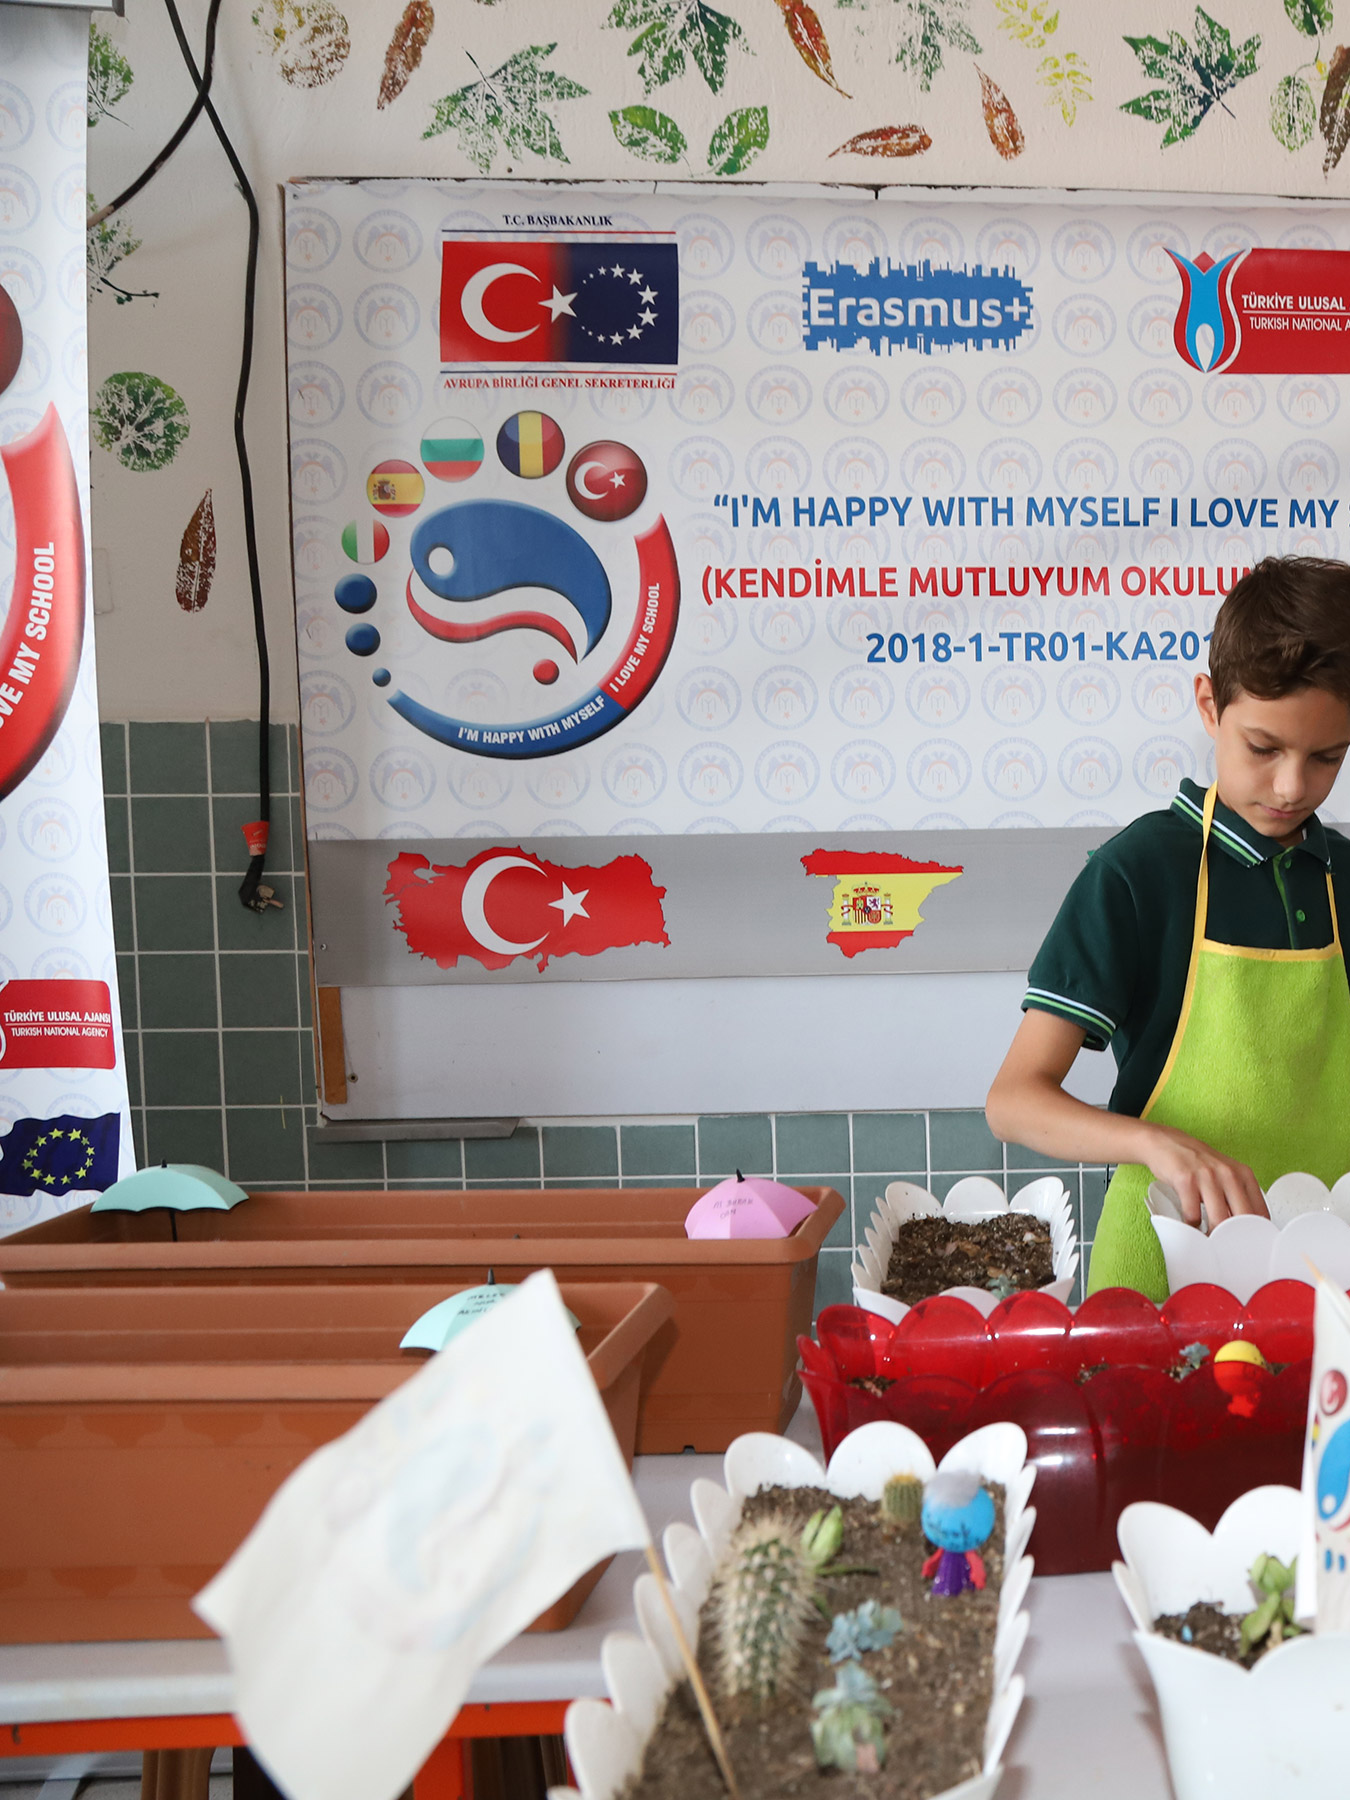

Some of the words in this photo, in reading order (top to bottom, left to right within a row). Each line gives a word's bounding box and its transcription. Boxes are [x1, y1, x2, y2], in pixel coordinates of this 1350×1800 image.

[503, 214, 525, 226] T.C.
[527, 214, 614, 229] BAŞBAKANLIK
[809, 288, 1028, 329] Erasmus+
[1241, 292, 1294, 310] TÜRKİYE
[1298, 296, 1346, 311] ULUSAL
[1250, 317, 1289, 331] TURKISH
[1292, 318, 1344, 332] NATIONAL
[443, 377, 490, 390] AVRUPA
[492, 375, 538, 389] BİRLİĞİ
[541, 377, 582, 389] GENEL
[585, 376, 676, 390] SEKRETERLİĞİ
[793, 496, 913, 528] HAPPY
[922, 496, 1014, 527] WITH
[1026, 496, 1161, 528] MYSELF
[1171, 497, 1178, 527] I
[1190, 497, 1279, 528] LOVE
[1288, 499, 1340, 529] MY
[701, 558, 899, 606] (KENDİMLE
[909, 566, 1111, 597] MUTLUYUM
[1120, 565, 1253, 597] OKULU
[8, 641, 41, 685] MY
[25, 541, 55, 641] SCHOOL
[618, 655, 641, 684] LOVE
[633, 634, 650, 657] MY
[642, 582, 660, 635] SCHOOL
[483, 730, 525, 744] HAPPY
[528, 722, 561, 742] WITH
[563, 695, 607, 733] MYSELF
[4, 1009, 44, 1022] TÜRKİYE
[47, 1011, 82, 1022] ULUSAL
[83, 1011, 111, 1024] AJANSI
[11, 1027, 42, 1038] TURKISH
[44, 1026, 80, 1037] NATIONAL
[81, 1027, 108, 1038] AGENCY
